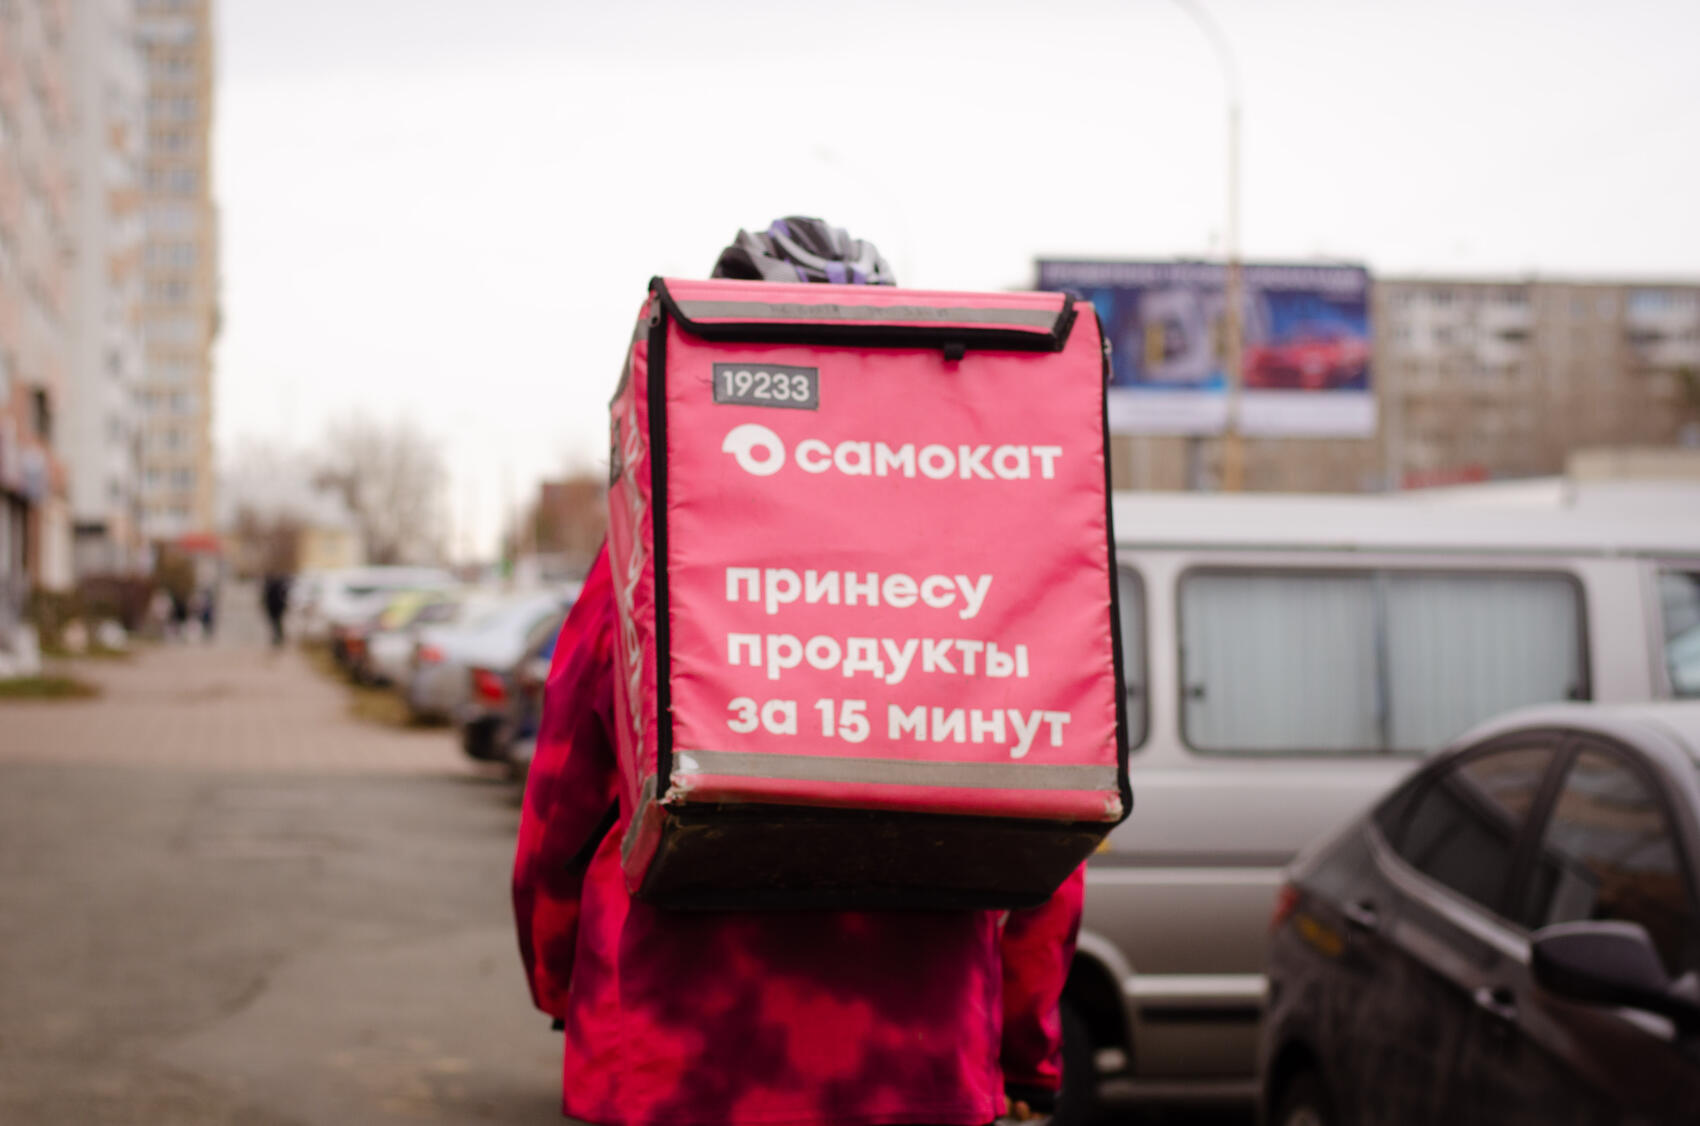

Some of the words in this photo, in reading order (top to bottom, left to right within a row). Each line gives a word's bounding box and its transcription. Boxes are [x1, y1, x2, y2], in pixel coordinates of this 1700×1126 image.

[723, 371, 810, 402] 19233
[795, 438, 1063, 480] самокат
[726, 567, 993, 620] принесу
[727, 632, 1029, 685] продукты
[727, 697, 797, 735] за
[814, 698, 870, 743] 15
[888, 704, 1071, 758] минут
